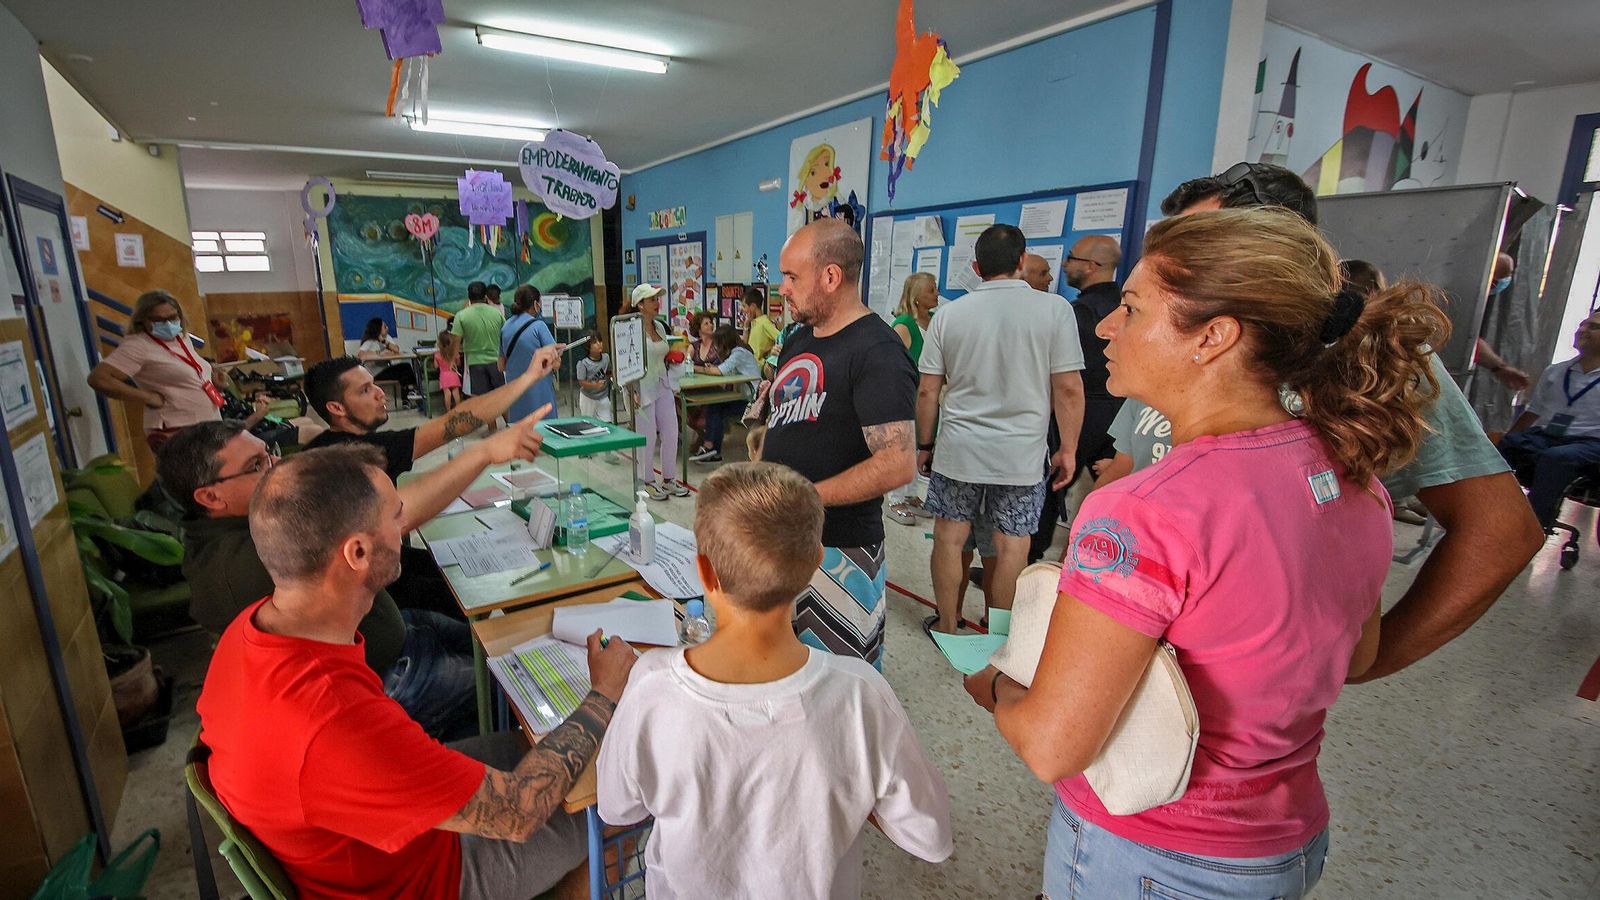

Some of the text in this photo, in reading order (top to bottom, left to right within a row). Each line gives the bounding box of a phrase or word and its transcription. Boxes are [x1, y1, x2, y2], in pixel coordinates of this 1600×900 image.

[522, 148, 618, 190] EMPODERAMIENTO
[542, 174, 597, 209] TRABAJO
[413, 217, 432, 233] 8M
